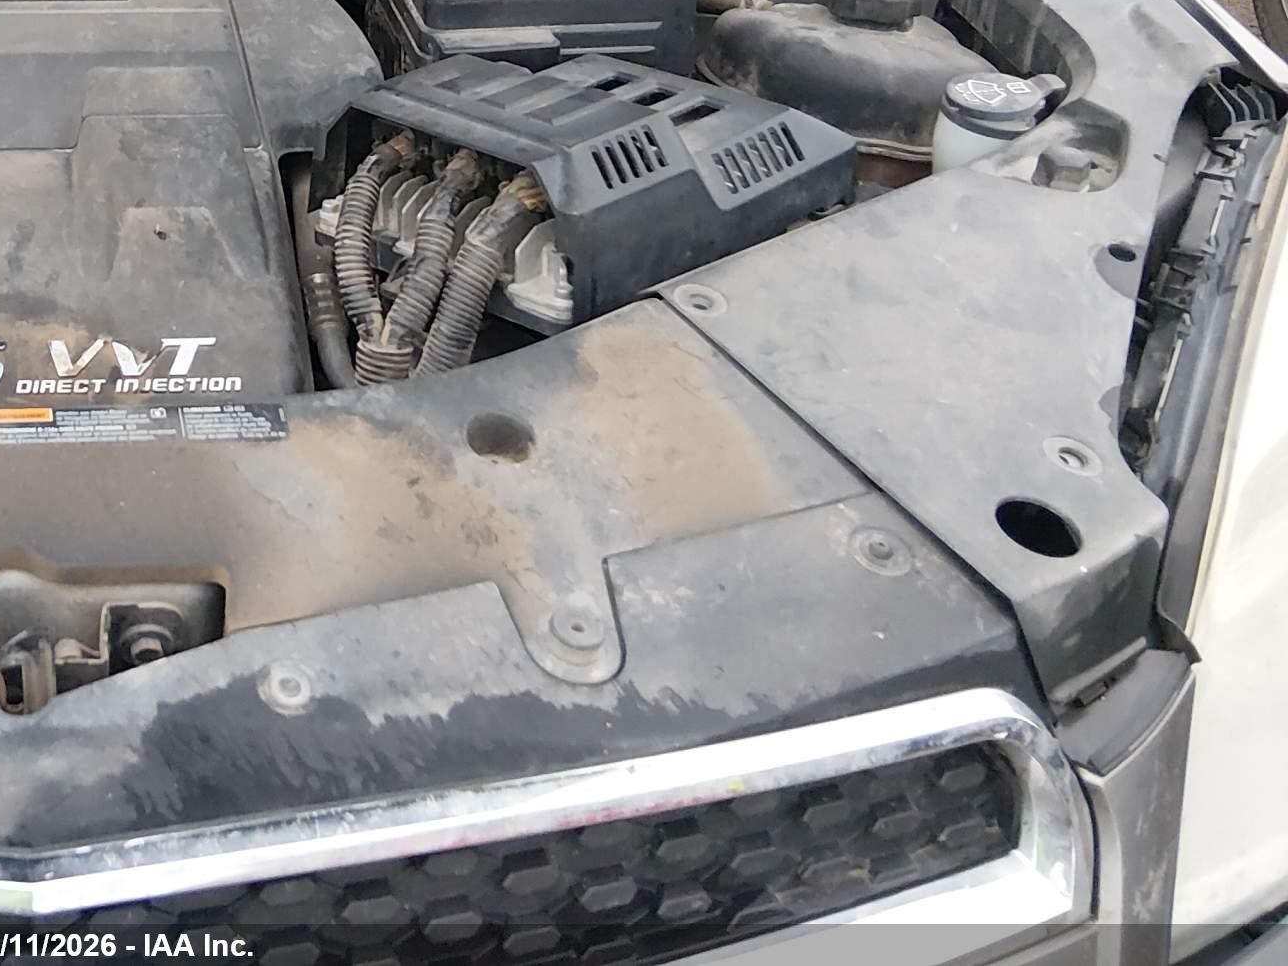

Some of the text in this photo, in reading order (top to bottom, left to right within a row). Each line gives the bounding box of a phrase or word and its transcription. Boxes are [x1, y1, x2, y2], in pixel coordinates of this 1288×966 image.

[48, 337, 217, 376] VVT
[16, 377, 243, 394] DIRECT INJECTION
